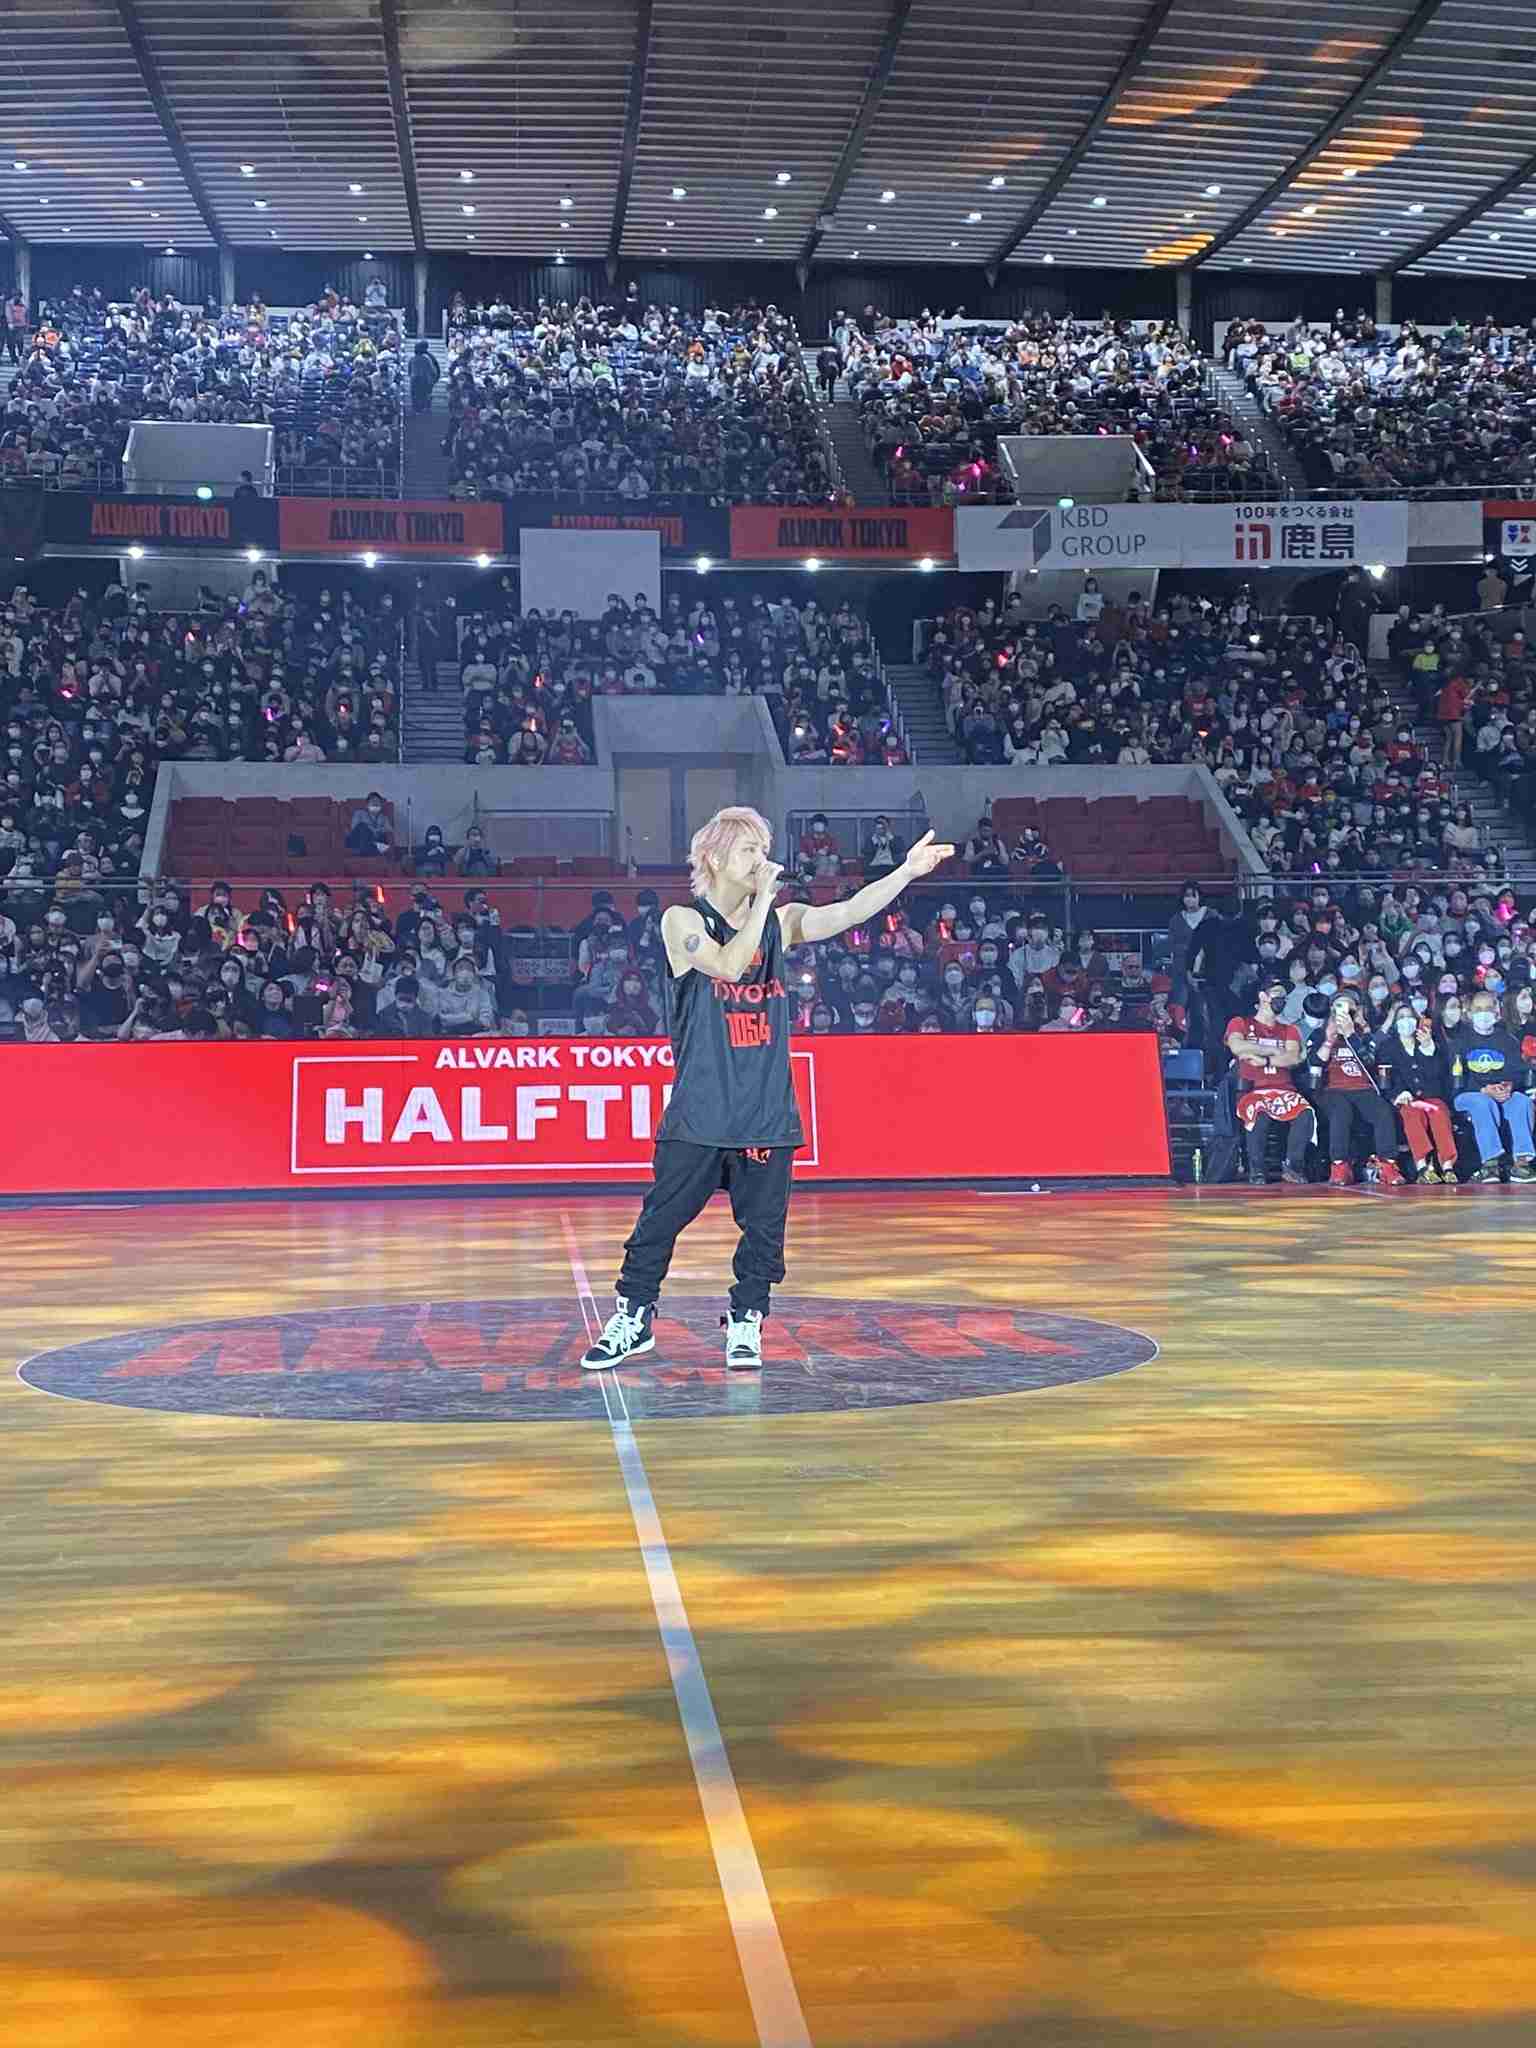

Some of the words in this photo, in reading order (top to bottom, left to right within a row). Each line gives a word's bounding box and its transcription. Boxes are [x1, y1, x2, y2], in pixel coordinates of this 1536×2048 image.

[167, 504, 230, 538] TOKYO
[1060, 507, 1109, 528] KBD
[1235, 506, 1354, 519] 100年をつくる会社
[1062, 534, 1147, 557] GROUP
[1281, 523, 1355, 559] 鹿島
[434, 1047, 560, 1069] ALVARK
[569, 1045, 674, 1067] TOKYO
[325, 1084, 673, 1143] HALFTI
